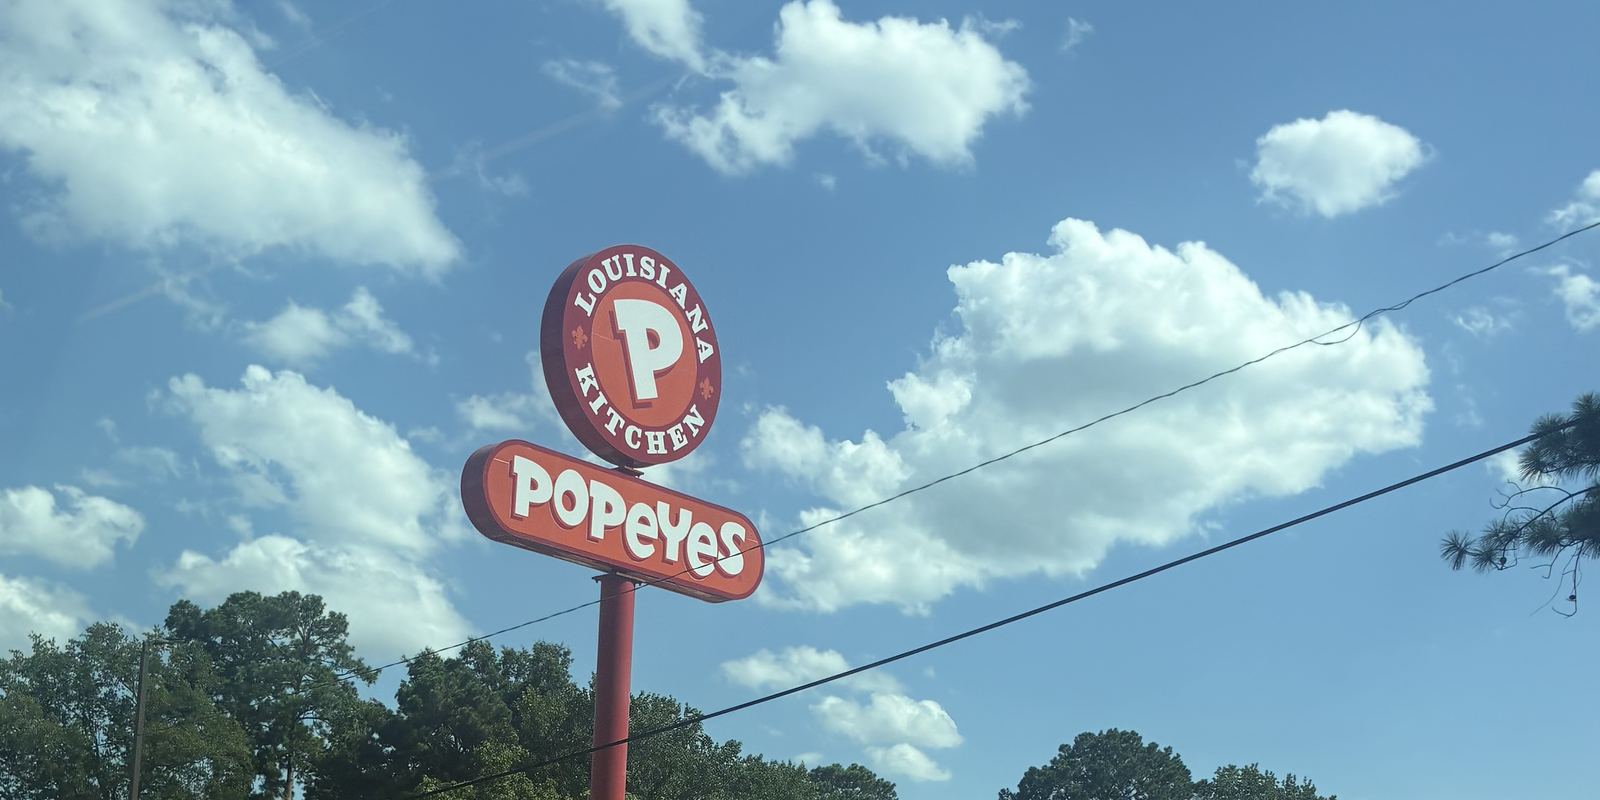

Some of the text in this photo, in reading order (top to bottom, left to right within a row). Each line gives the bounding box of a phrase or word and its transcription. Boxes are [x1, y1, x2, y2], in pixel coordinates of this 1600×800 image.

[574, 253, 714, 364] LOUISIANA
[613, 298, 684, 400] P
[575, 362, 705, 455] KITCHEN
